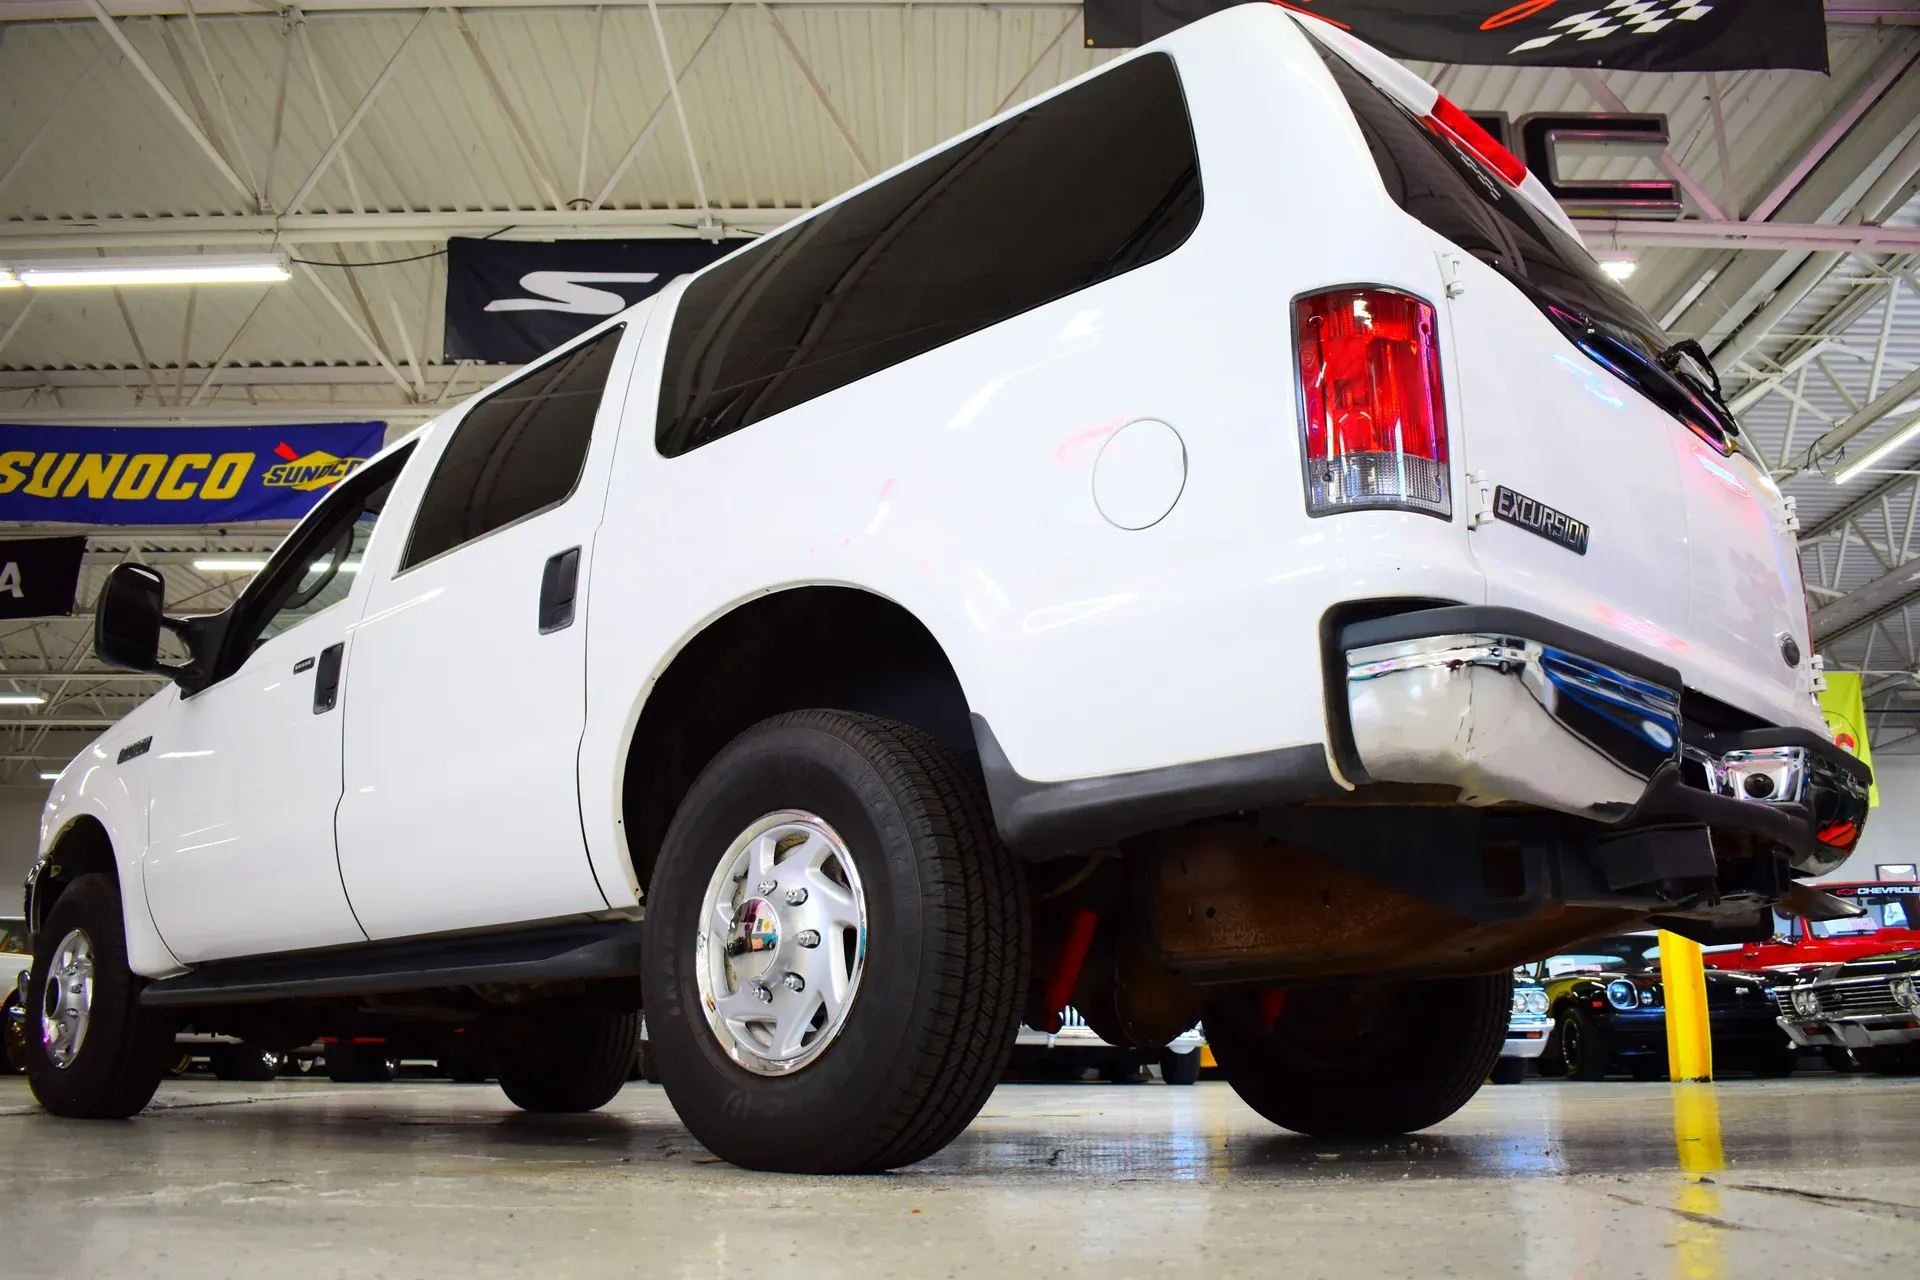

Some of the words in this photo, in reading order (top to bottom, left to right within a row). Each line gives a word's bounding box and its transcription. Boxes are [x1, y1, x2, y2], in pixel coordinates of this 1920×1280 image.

[1466, 111, 1684, 222] C
[0, 451, 256, 500] SUNOCO
[1497, 486, 1590, 549] EXCURSION
